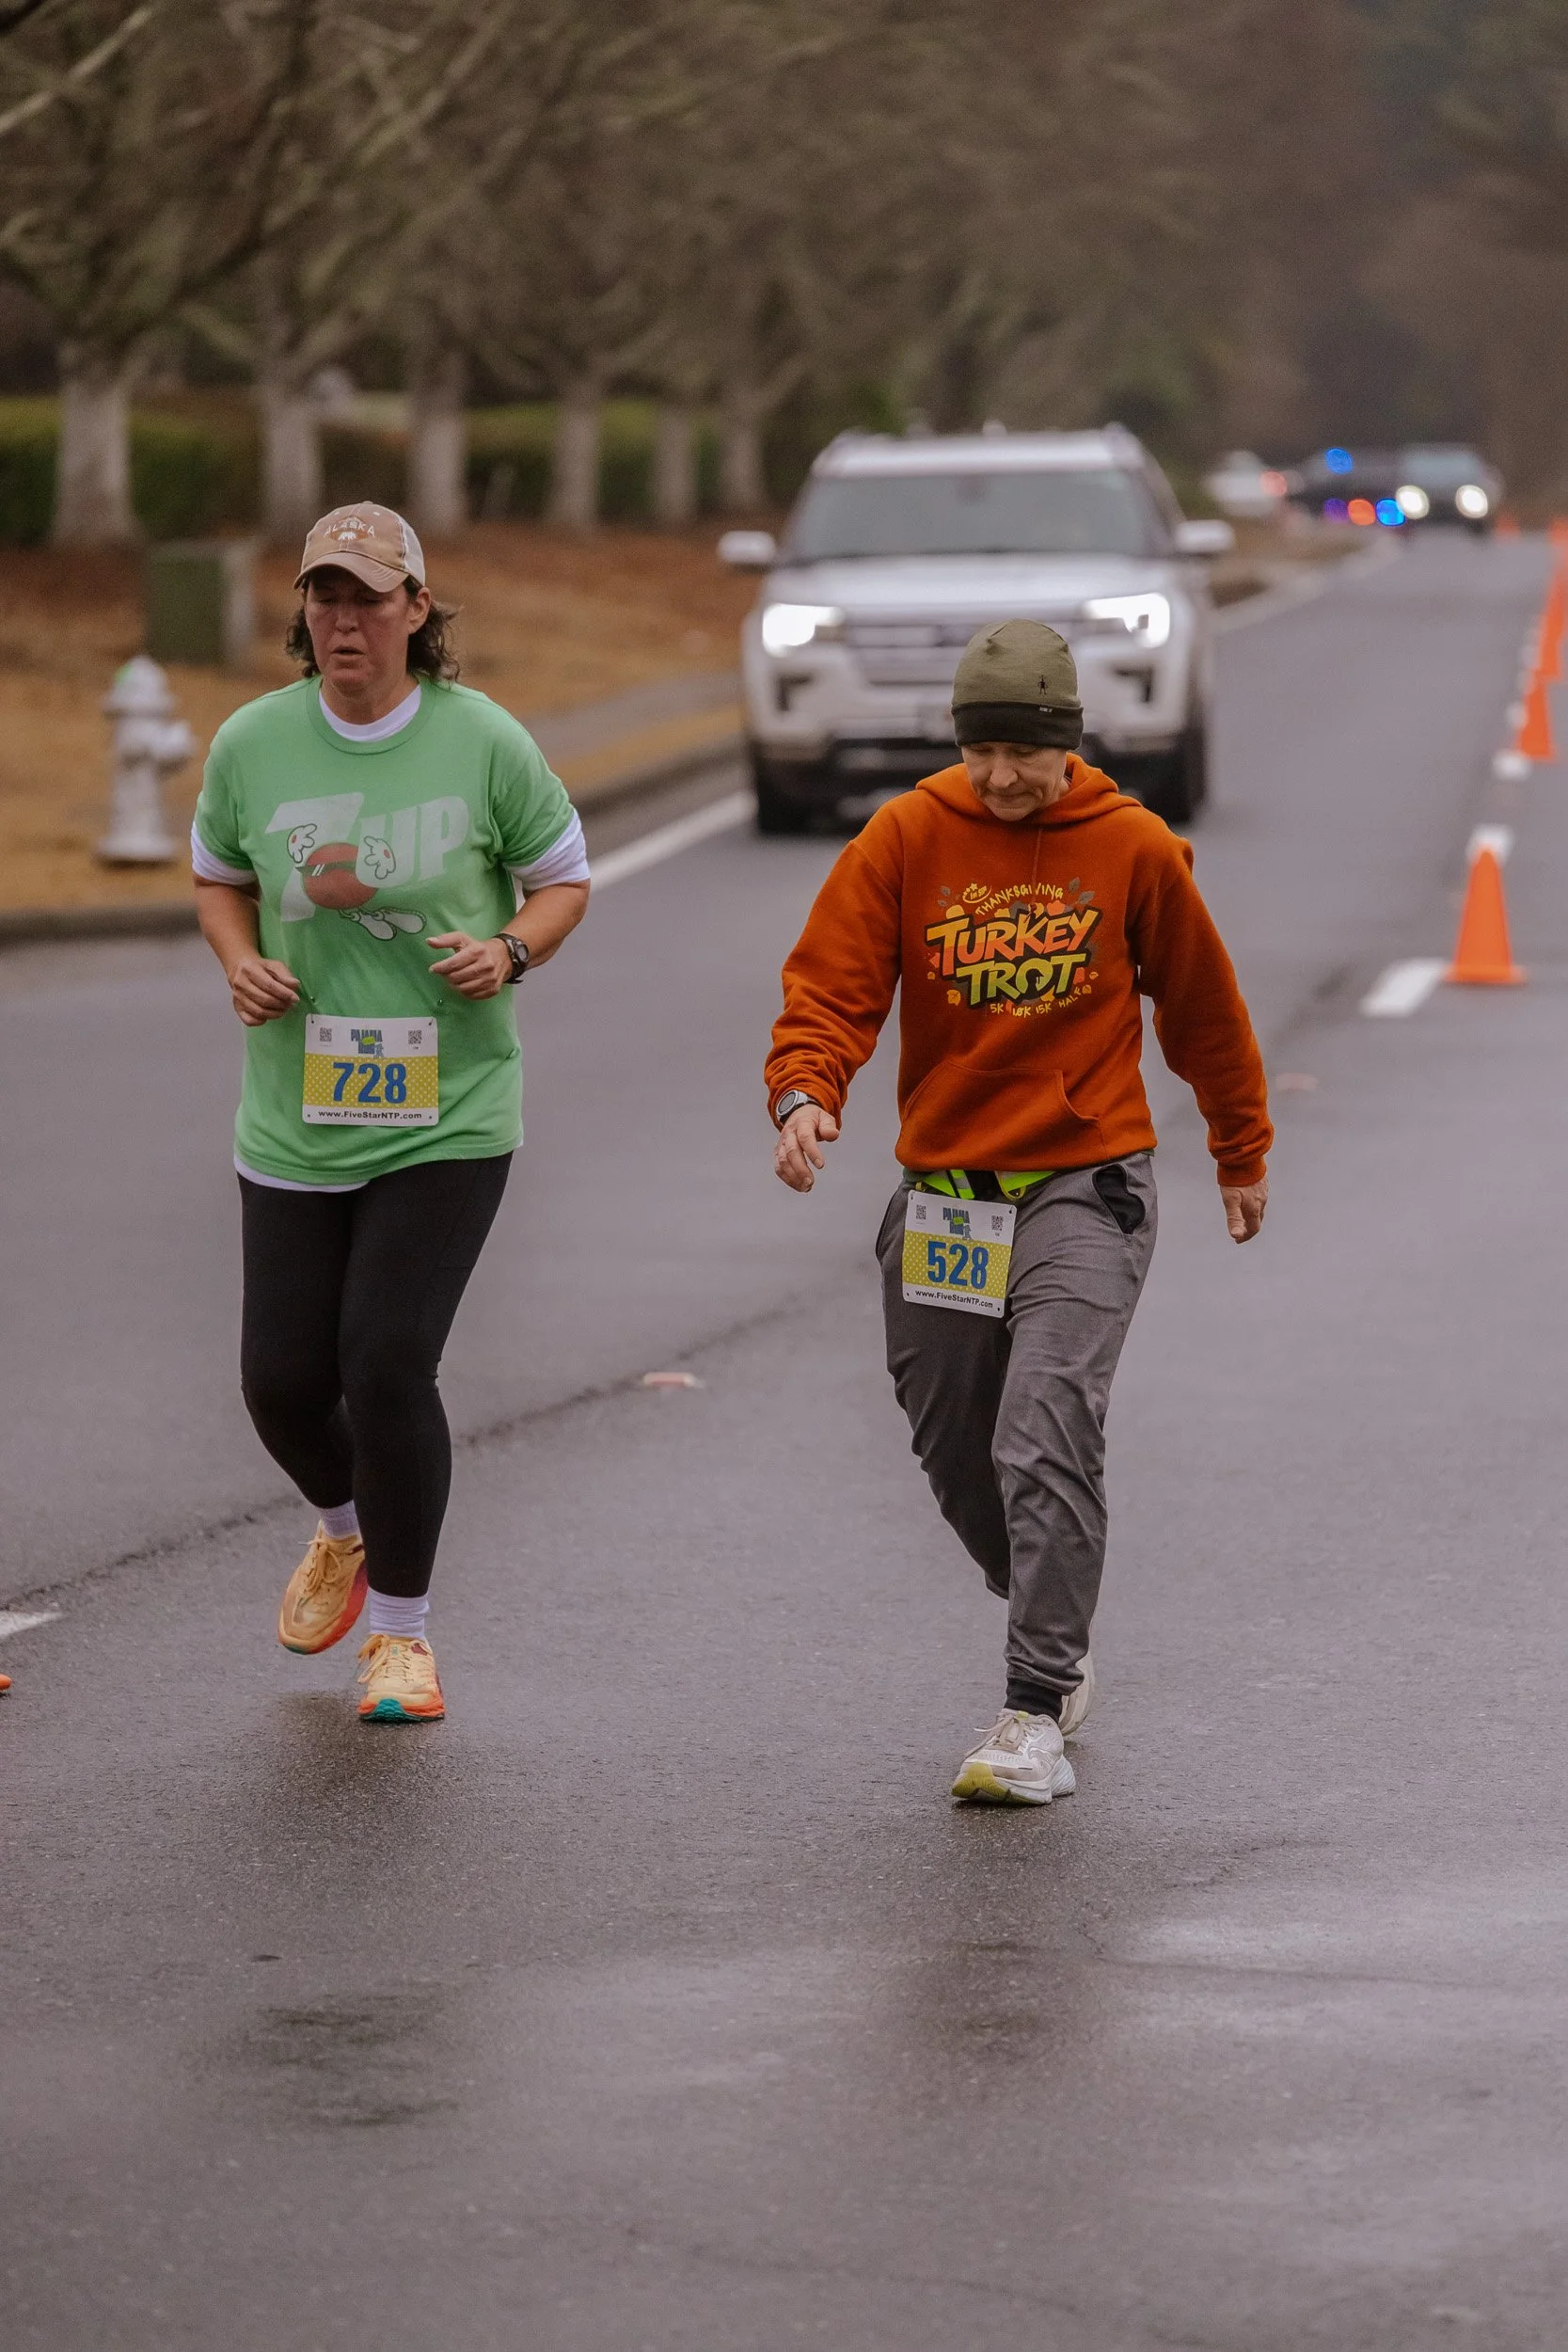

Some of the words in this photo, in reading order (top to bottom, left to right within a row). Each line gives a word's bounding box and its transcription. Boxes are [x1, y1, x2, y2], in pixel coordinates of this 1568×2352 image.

[323, 518, 375, 538] ALASKA
[927, 909, 1100, 977] TURKEY
[956, 953, 1086, 1006] TROT
[990, 1003, 1005, 1015] 5K
[1012, 1006, 1031, 1018] 10K
[1036, 1002, 1052, 1014] 15K
[333, 1062, 407, 1104] 728
[318, 1111, 422, 1120] www.FiveStarNTP.com
[927, 1240, 989, 1290] 528
[915, 1290, 993, 1309] www.FiveStarNTP.com
